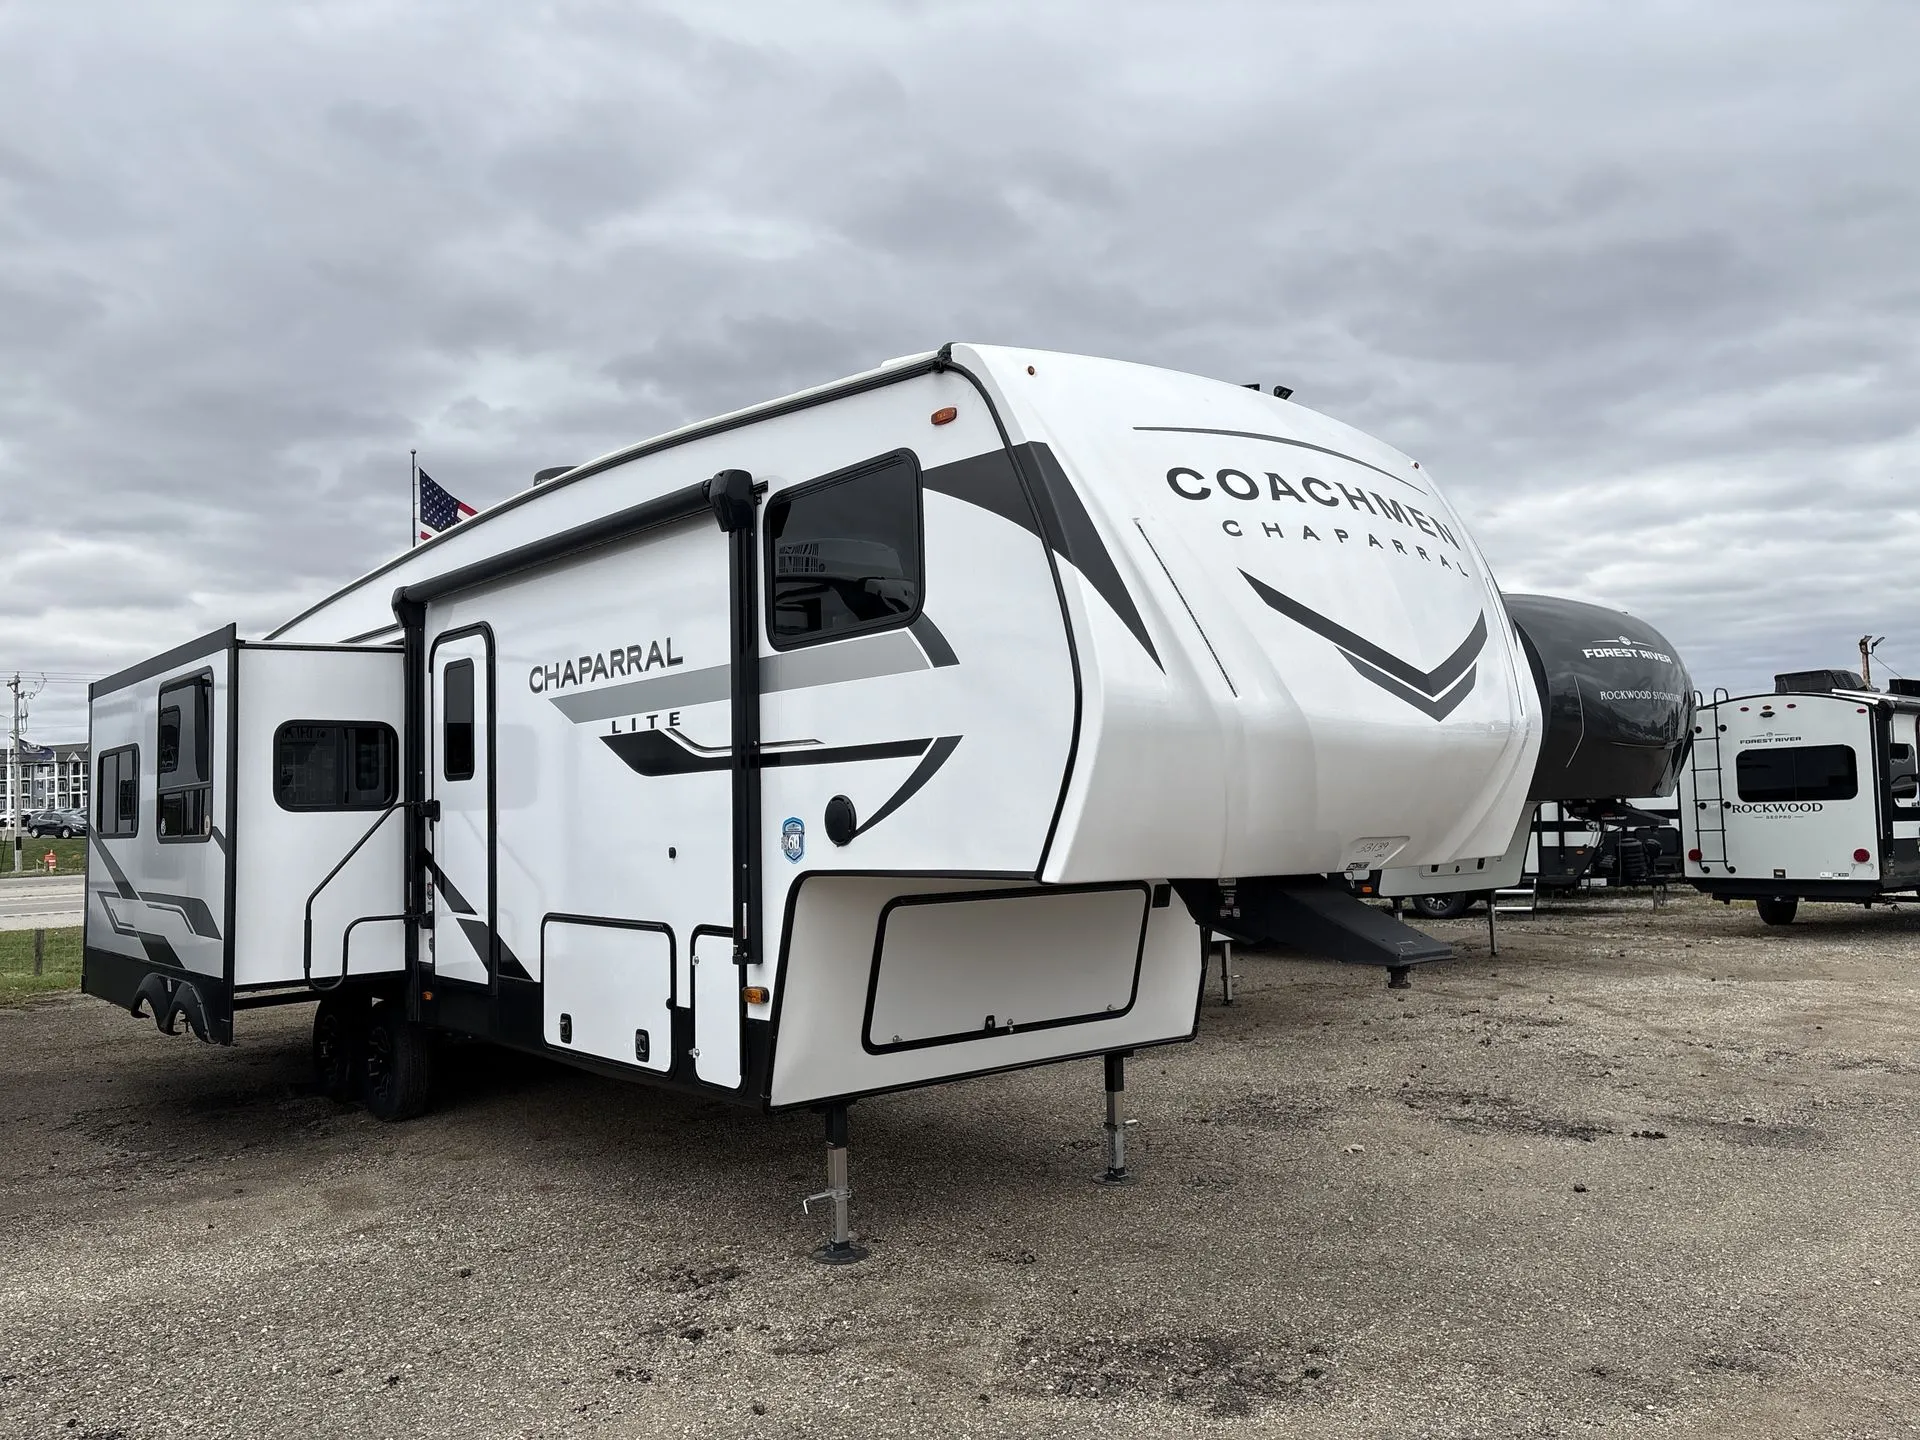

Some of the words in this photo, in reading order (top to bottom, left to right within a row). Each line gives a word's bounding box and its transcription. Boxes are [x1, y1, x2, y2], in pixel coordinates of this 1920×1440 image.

[1165, 466, 1462, 551] COACHMEN
[1221, 519, 1469, 578] CHAPARRAL
[529, 637, 684, 695] CHAPARRAL
[1582, 648, 1638, 659] FOREST
[1638, 649, 1672, 665] RIVER
[1600, 690, 1652, 701] ROCKWOOD
[611, 711, 681, 735] LITE
[1732, 802, 1824, 814] ROCKWOOD
